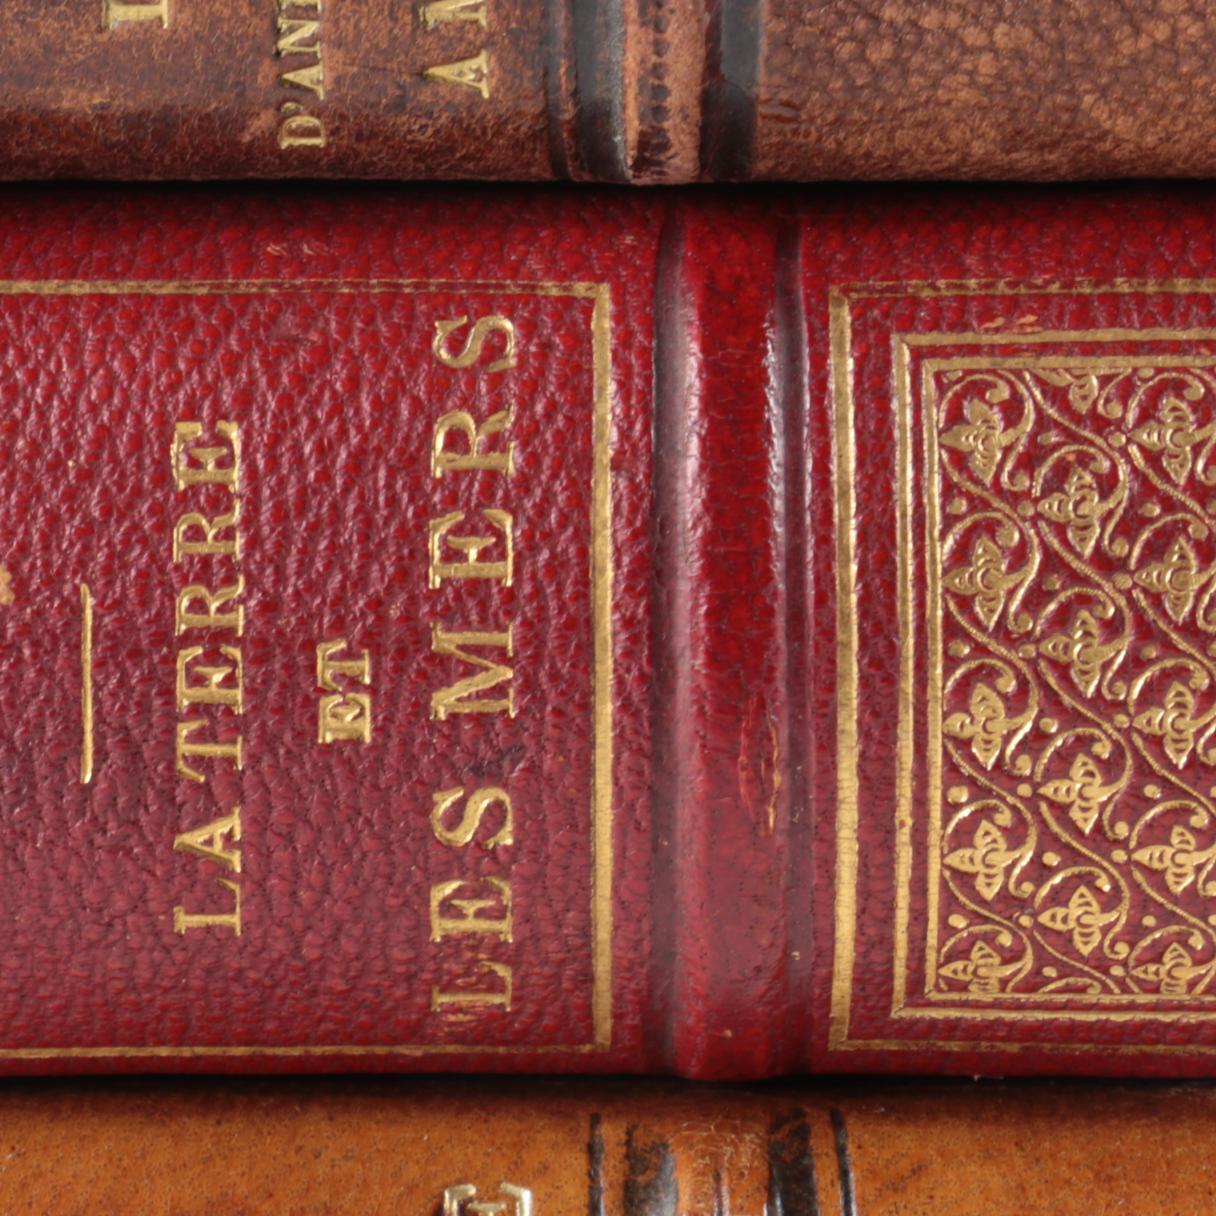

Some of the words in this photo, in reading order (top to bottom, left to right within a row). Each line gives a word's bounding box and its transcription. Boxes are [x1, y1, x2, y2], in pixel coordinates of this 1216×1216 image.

[170, 420, 245, 783] TERRE
[428, 315, 517, 720] MERS
[317, 639, 372, 744] ET
[174, 806, 243, 936] LA
[430, 787, 515, 1013] LES
